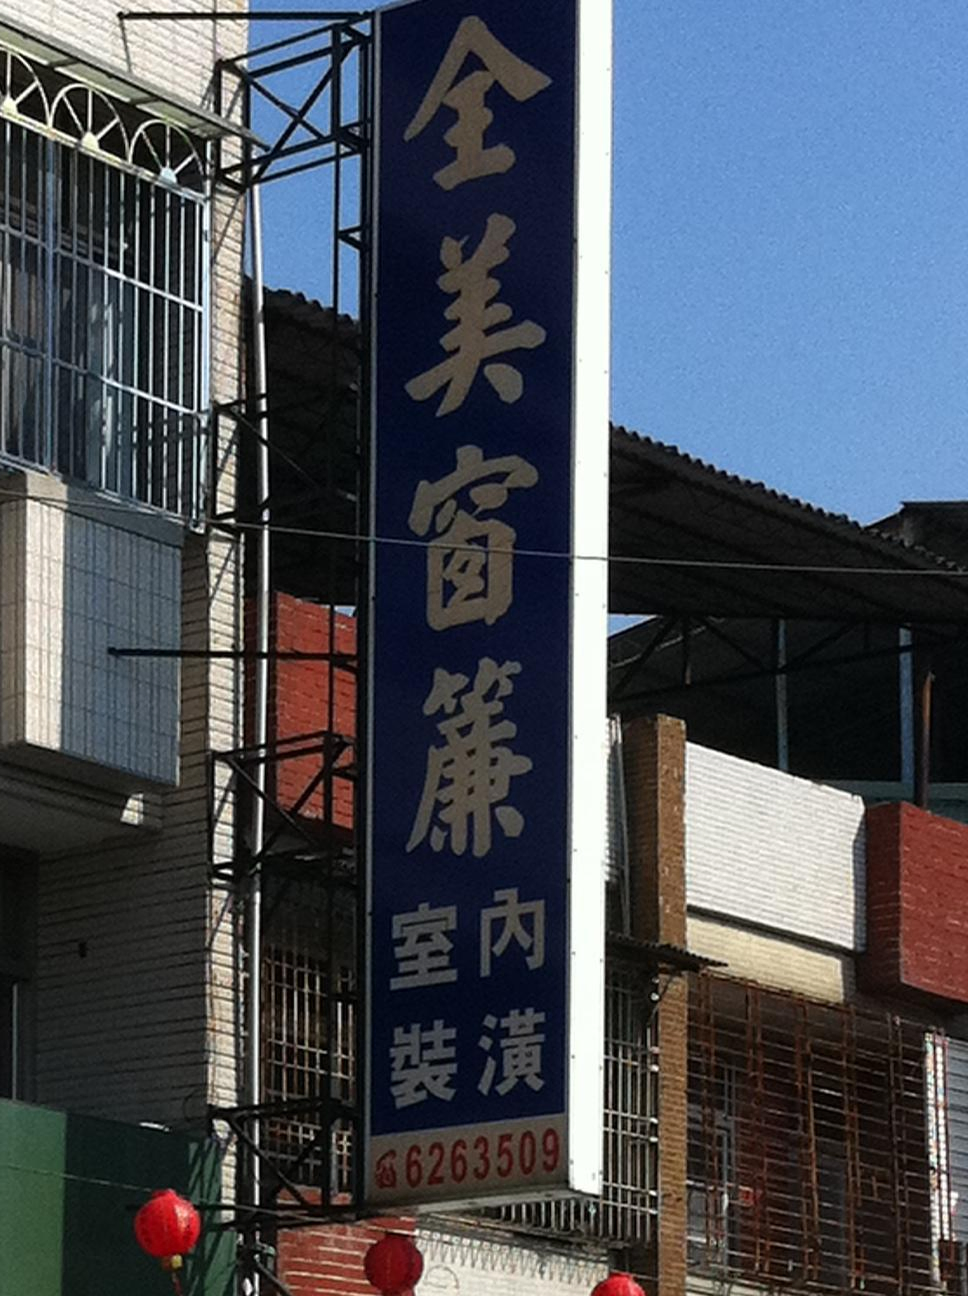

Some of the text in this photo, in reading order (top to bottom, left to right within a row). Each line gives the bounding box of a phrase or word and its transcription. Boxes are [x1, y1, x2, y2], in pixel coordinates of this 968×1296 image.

[403, 15, 553, 857] 全美窗簾
[389, 888, 546, 991] 室內
[388, 1007, 546, 1110] 裝潢
[406, 1127, 561, 1190] 6263509
